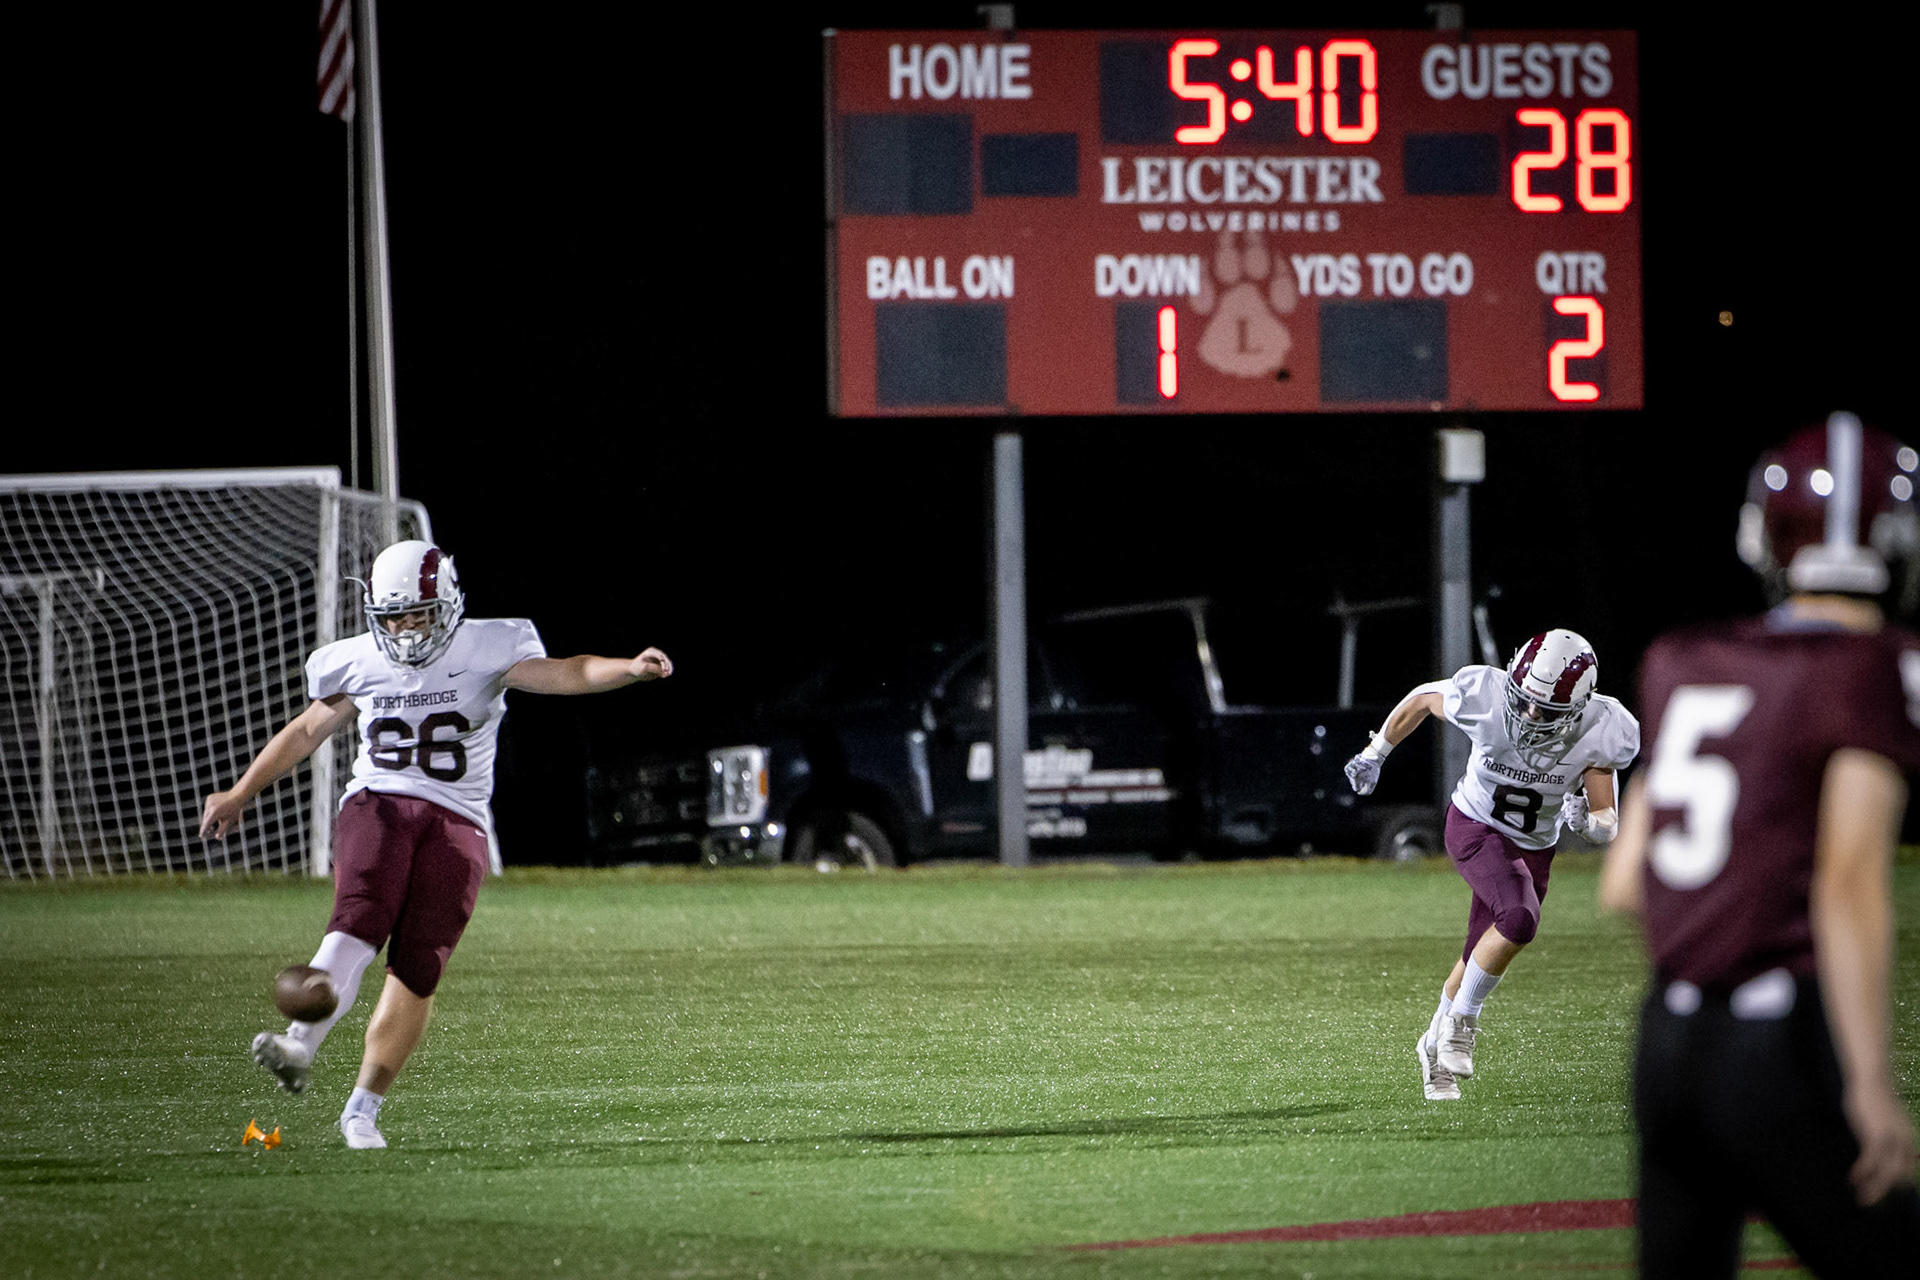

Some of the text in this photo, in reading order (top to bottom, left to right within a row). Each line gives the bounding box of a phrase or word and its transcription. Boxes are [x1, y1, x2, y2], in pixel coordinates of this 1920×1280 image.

[888, 43, 1033, 100] HOME
[1168, 38, 1379, 145] 5:40
[1421, 43, 1612, 99] GUESTS
[1101, 156, 1384, 204] LEICESTER
[1511, 107, 1632, 214] 28
[1138, 210, 1342, 234] WOLVERINES
[866, 255, 1016, 301] BALL ON
[1094, 253, 1201, 300] DOWN
[1291, 253, 1475, 297] YDS TO GO
[1535, 251, 1608, 295] QTR
[1156, 305, 1179, 400] 1
[1547, 295, 1606, 403] 2
[372, 689, 458, 710] NORTHBRIDGE
[1483, 757, 1565, 785] NORTHBRIDGE
[1650, 684, 1754, 890] 5
[1490, 783, 1544, 834] 8
